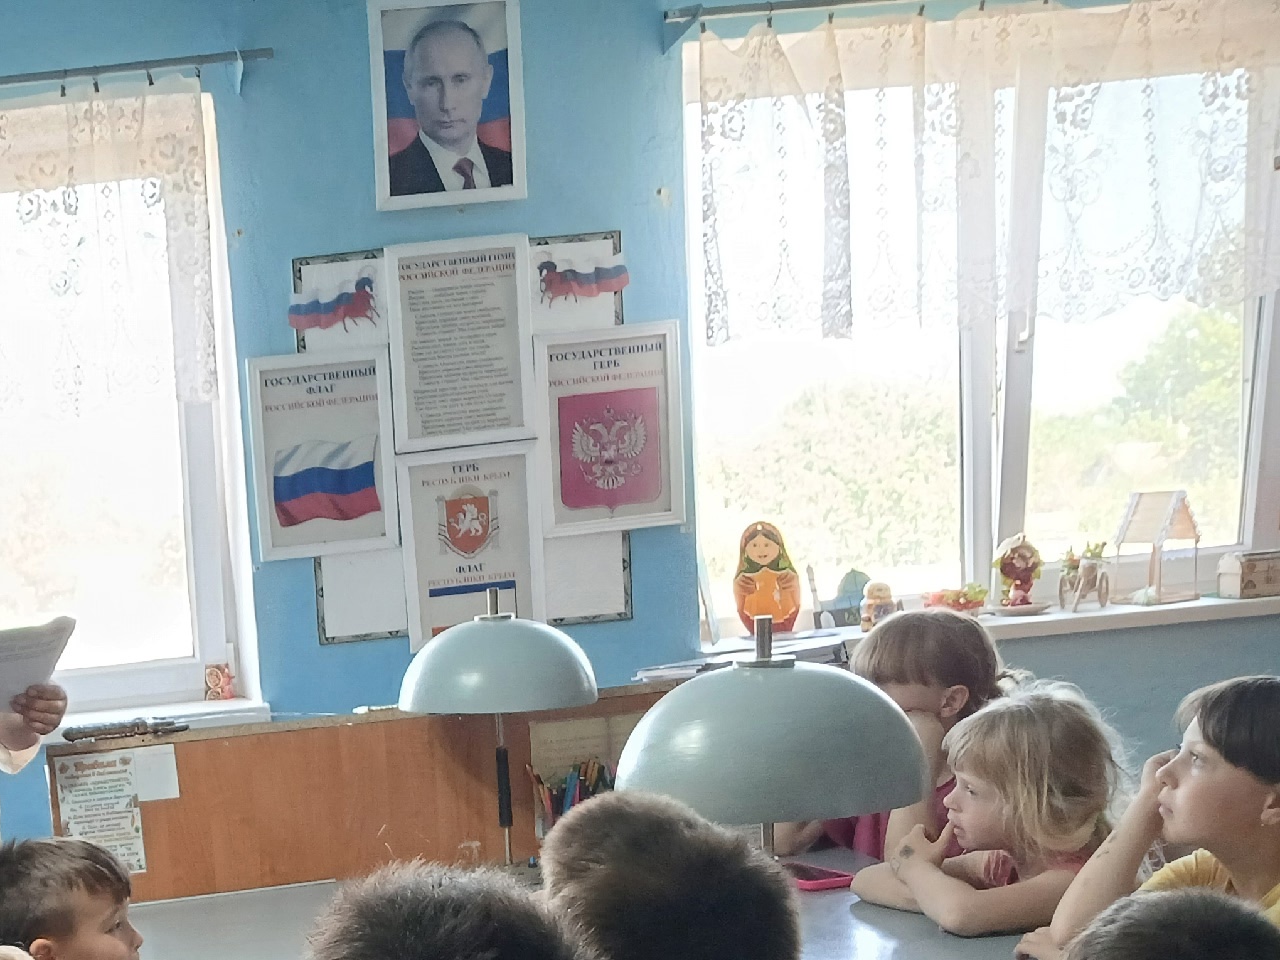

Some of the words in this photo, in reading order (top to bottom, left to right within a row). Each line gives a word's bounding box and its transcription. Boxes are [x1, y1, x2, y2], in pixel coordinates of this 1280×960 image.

[549, 341, 662, 362] ГОСУДАРСТВЕННЫЙ
[593, 359, 620, 370] ГЕРБ
[264, 366, 376, 387] ГОСУДАРСТВЕННЫЙ
[306, 383, 336, 394] ФЛАГ
[452, 463, 480, 474] ГЕРБ
[455, 563, 485, 574] ФЛАГ
